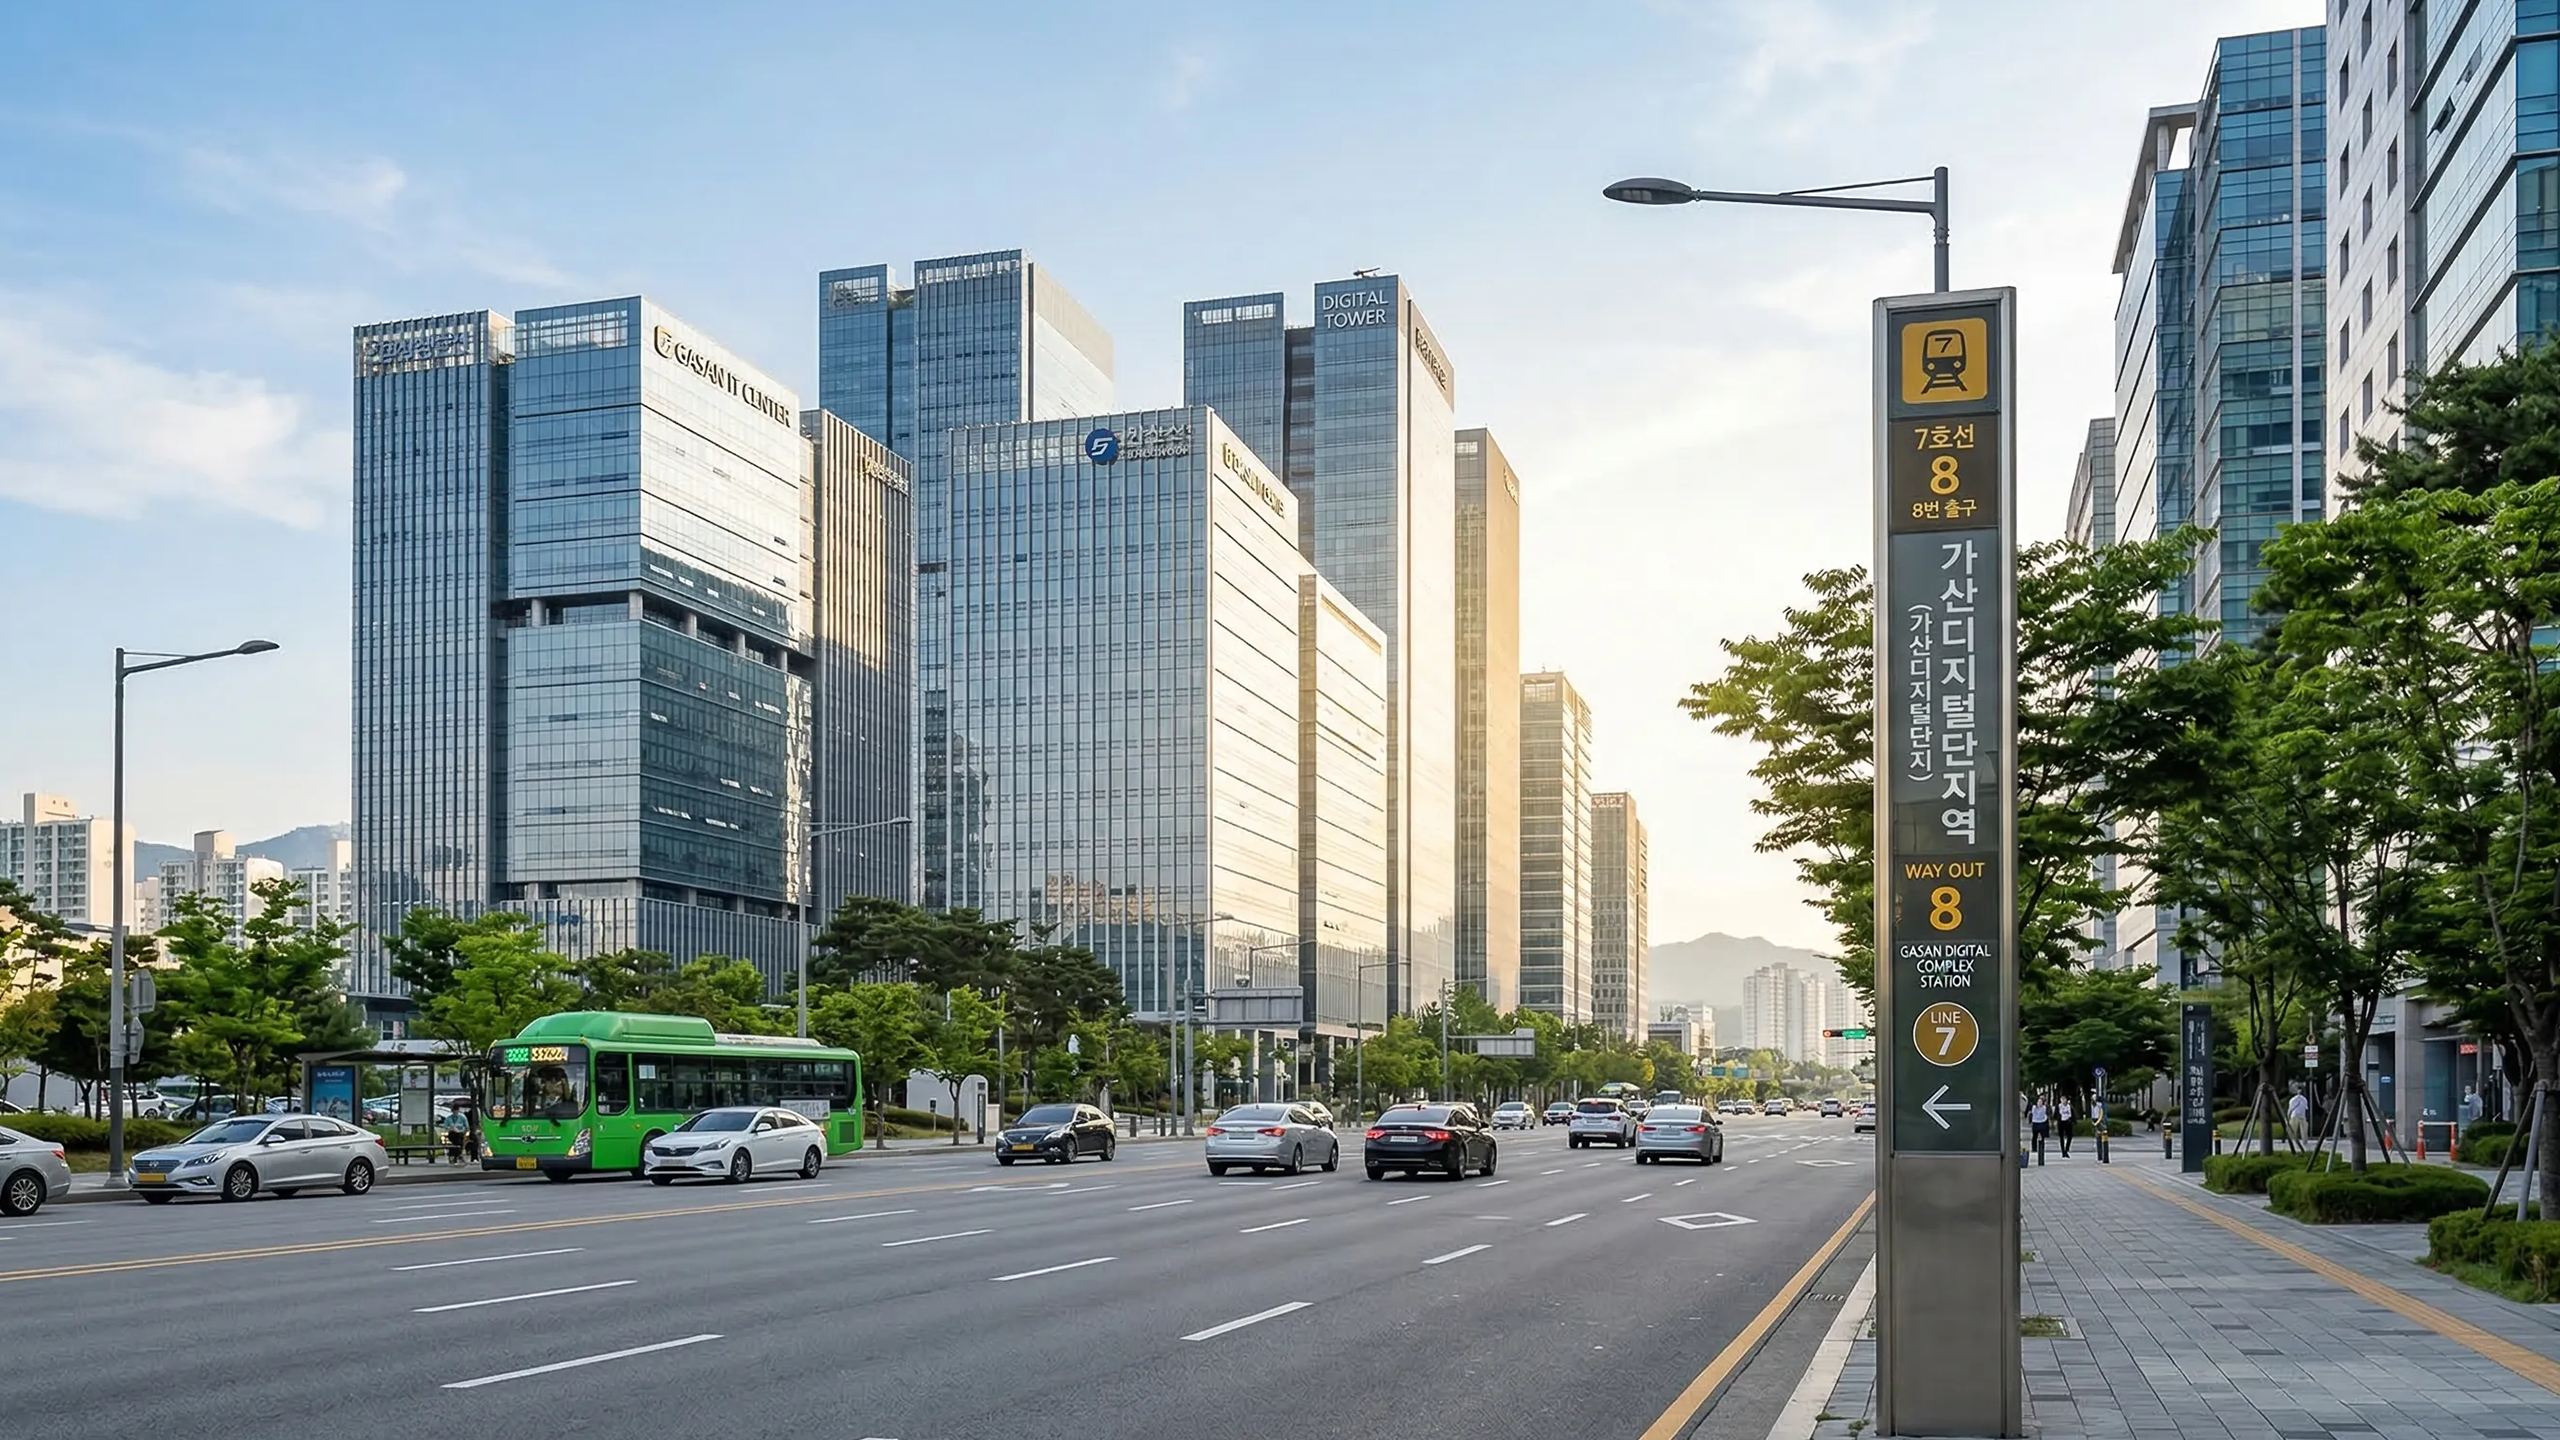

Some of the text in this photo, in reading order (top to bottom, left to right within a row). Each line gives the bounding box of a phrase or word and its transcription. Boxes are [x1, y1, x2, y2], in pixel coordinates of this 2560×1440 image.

[1323, 289, 1389, 310] DIGITAL
[1323, 308, 1386, 329] TOWER
[1934, 336, 1953, 354] 7
[673, 342, 725, 389] GASAN
[727, 371, 741, 396] IT
[1914, 424, 1975, 450] 7호선
[1929, 454, 1960, 496] 8
[1912, 499, 1977, 519] 8번 출구
[1907, 603, 1934, 782] (가산디지털단지)
[1939, 538, 1978, 846] 가산디지털단지역
[1904, 862, 1985, 880] WAY OUT
[1929, 885, 1963, 932] 8
[1900, 944, 1992, 958] GASAN DIGITAL
[1916, 958, 1975, 973] COMPLEX
[1920, 974, 1971, 988] STATION
[1930, 1011, 1961, 1024] LINE
[1935, 1026, 1956, 1056] 7
